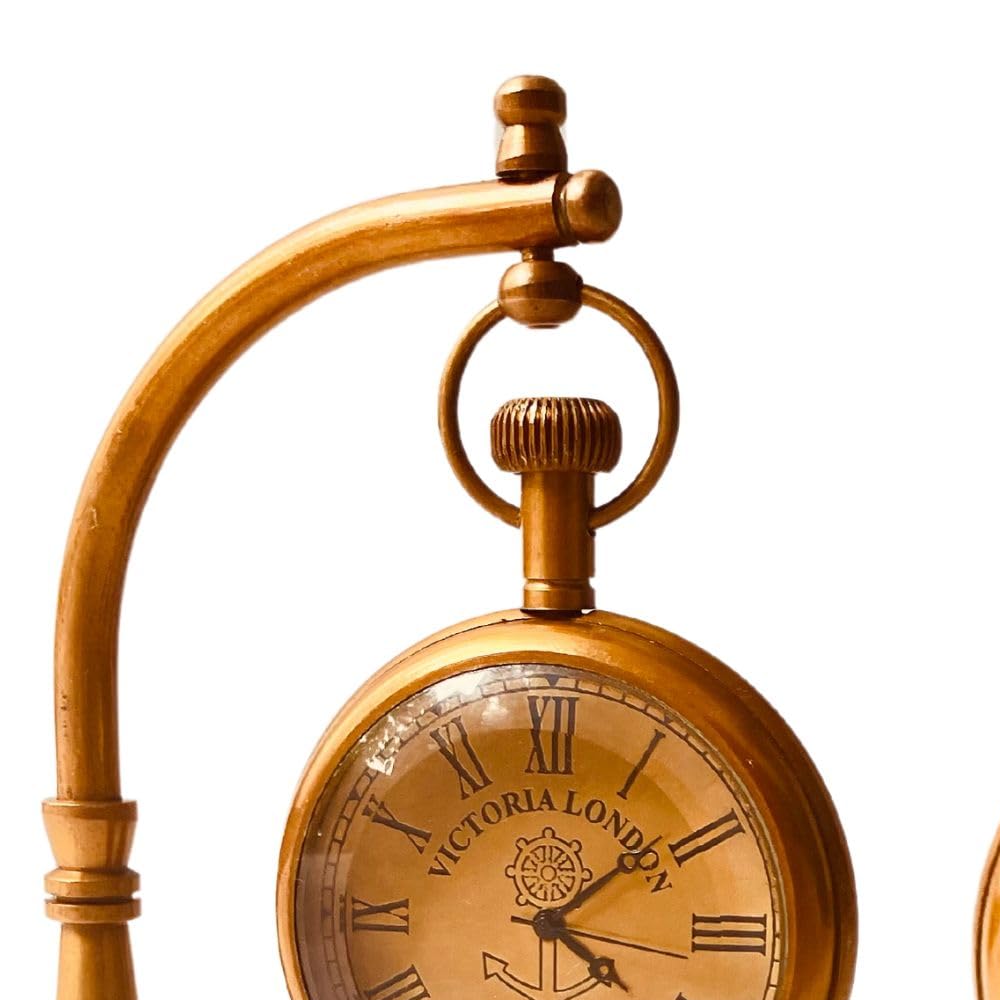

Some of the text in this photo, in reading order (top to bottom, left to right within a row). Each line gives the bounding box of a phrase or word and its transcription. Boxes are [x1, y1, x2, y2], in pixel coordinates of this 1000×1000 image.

[429, 715, 491, 801] XI
[524, 695, 579, 775] XII
[617, 729, 666, 800] I
[363, 793, 433, 854] X
[427, 788, 673, 893] VICTORIA LONDON
[668, 808, 747, 866] II
[691, 913, 768, 956] III
